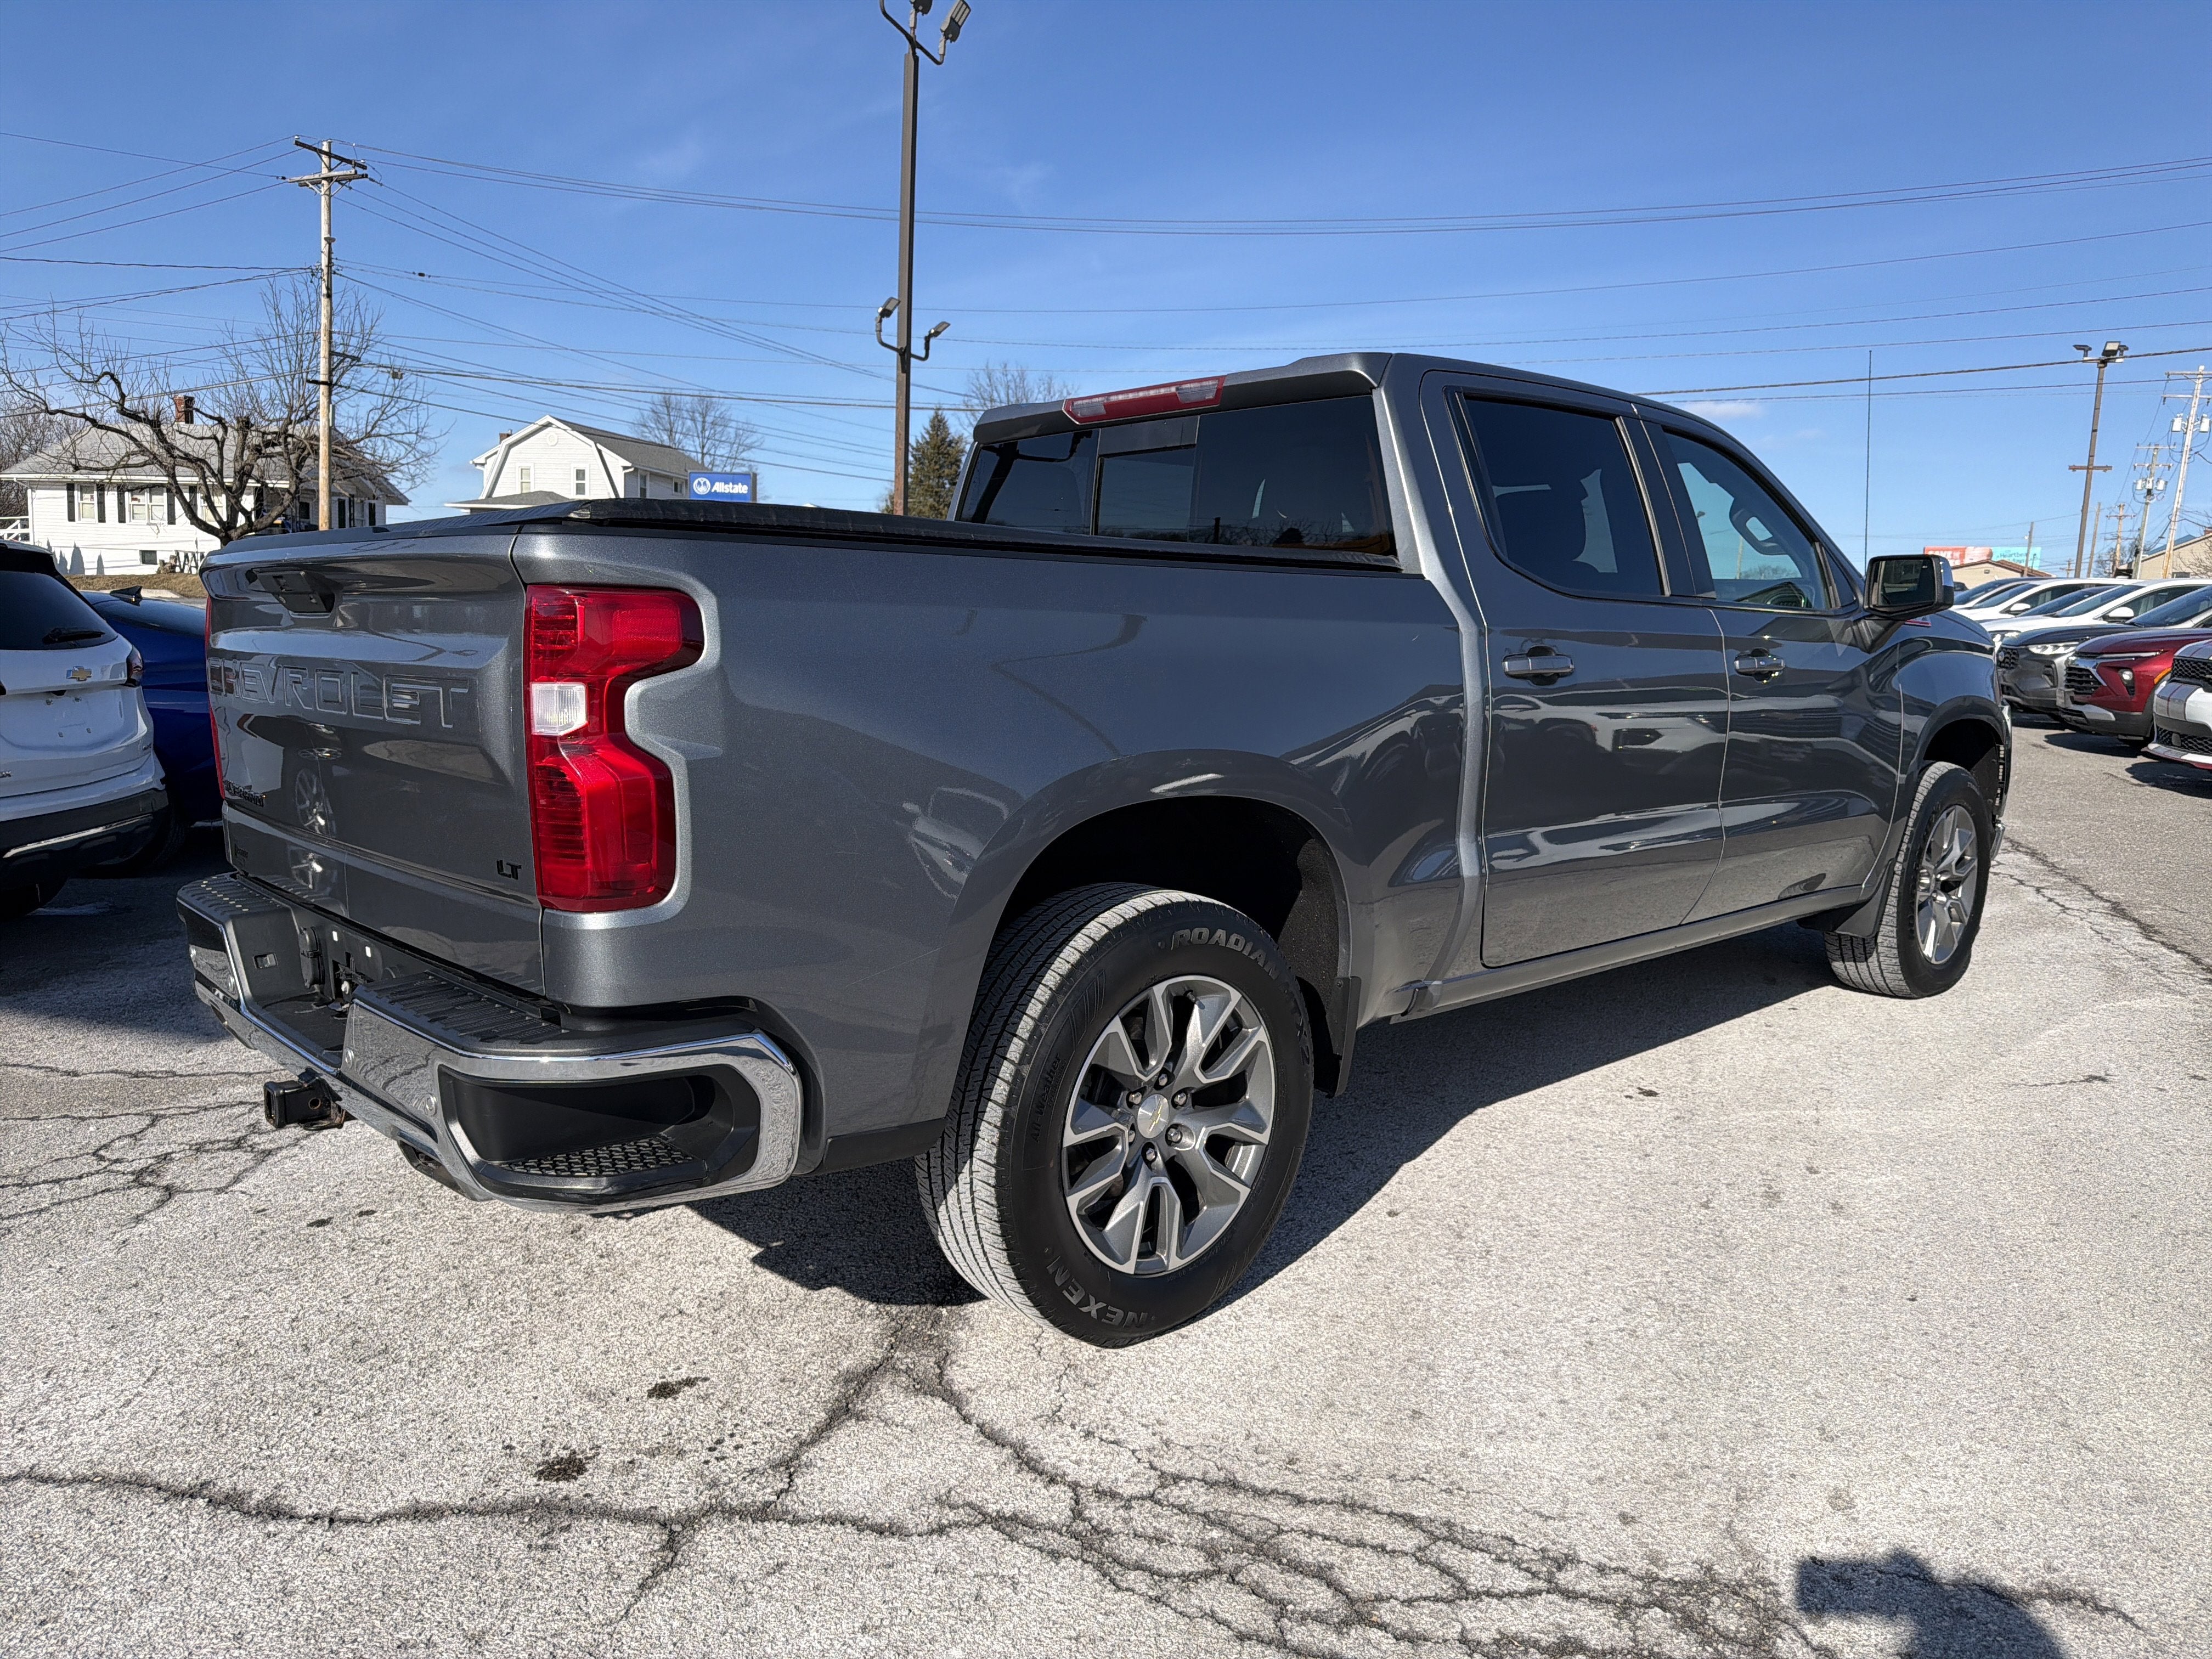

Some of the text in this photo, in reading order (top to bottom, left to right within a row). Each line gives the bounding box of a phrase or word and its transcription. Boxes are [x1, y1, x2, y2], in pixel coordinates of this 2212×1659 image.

[711, 482, 748, 494] Allstate
[208, 657, 470, 729] CHEVROLET
[496, 859, 522, 881] LT
[1171, 927, 1282, 980] ROADIAN
[1031, 1053, 1062, 1143] All-Weather
[1046, 1255, 1149, 1329] NEXEN
